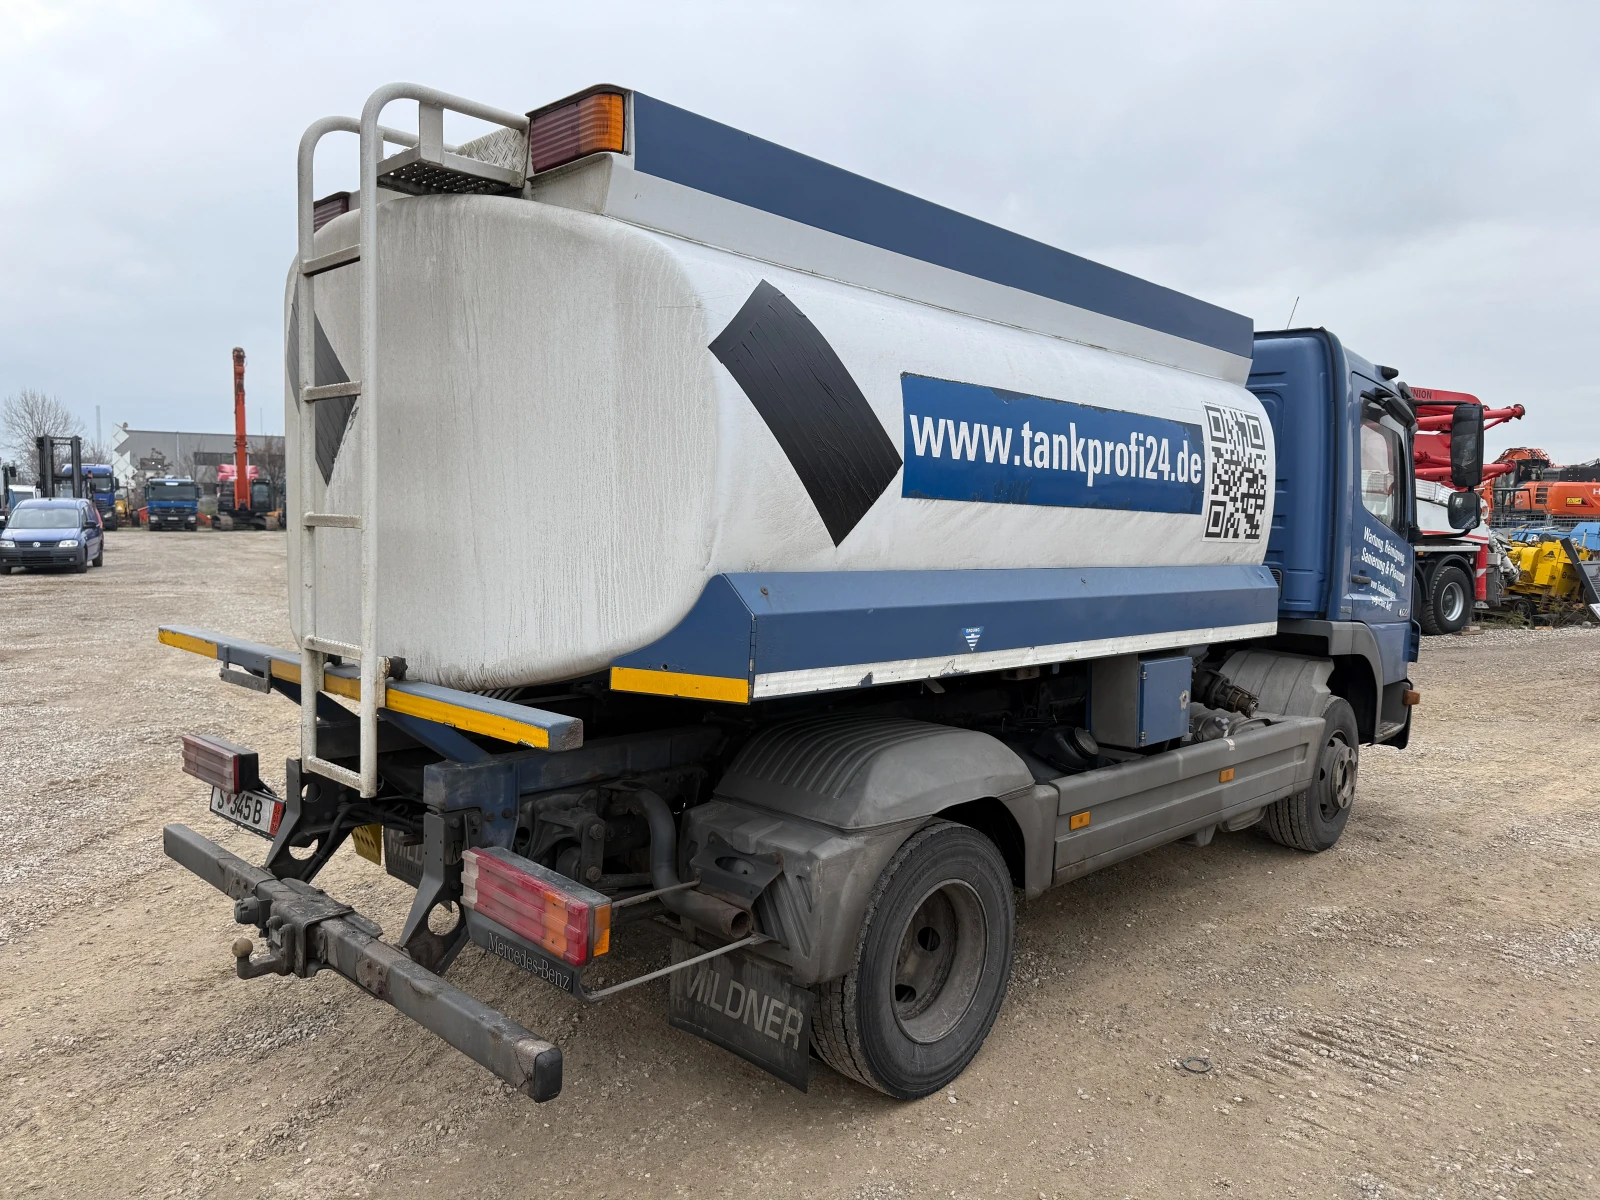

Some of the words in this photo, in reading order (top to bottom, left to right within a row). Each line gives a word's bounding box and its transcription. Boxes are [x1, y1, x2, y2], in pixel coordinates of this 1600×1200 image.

[1411, 388, 1433, 401] NION
[909, 415, 1202, 488] www.tankprofi24.de
[1361, 547, 1385, 575] Sanierung
[1385, 561, 1390, 574] &
[1389, 563, 1405, 587] Planung
[388, 829, 424, 866] MILD
[488, 932, 570, 991] Mercedes-Benz
